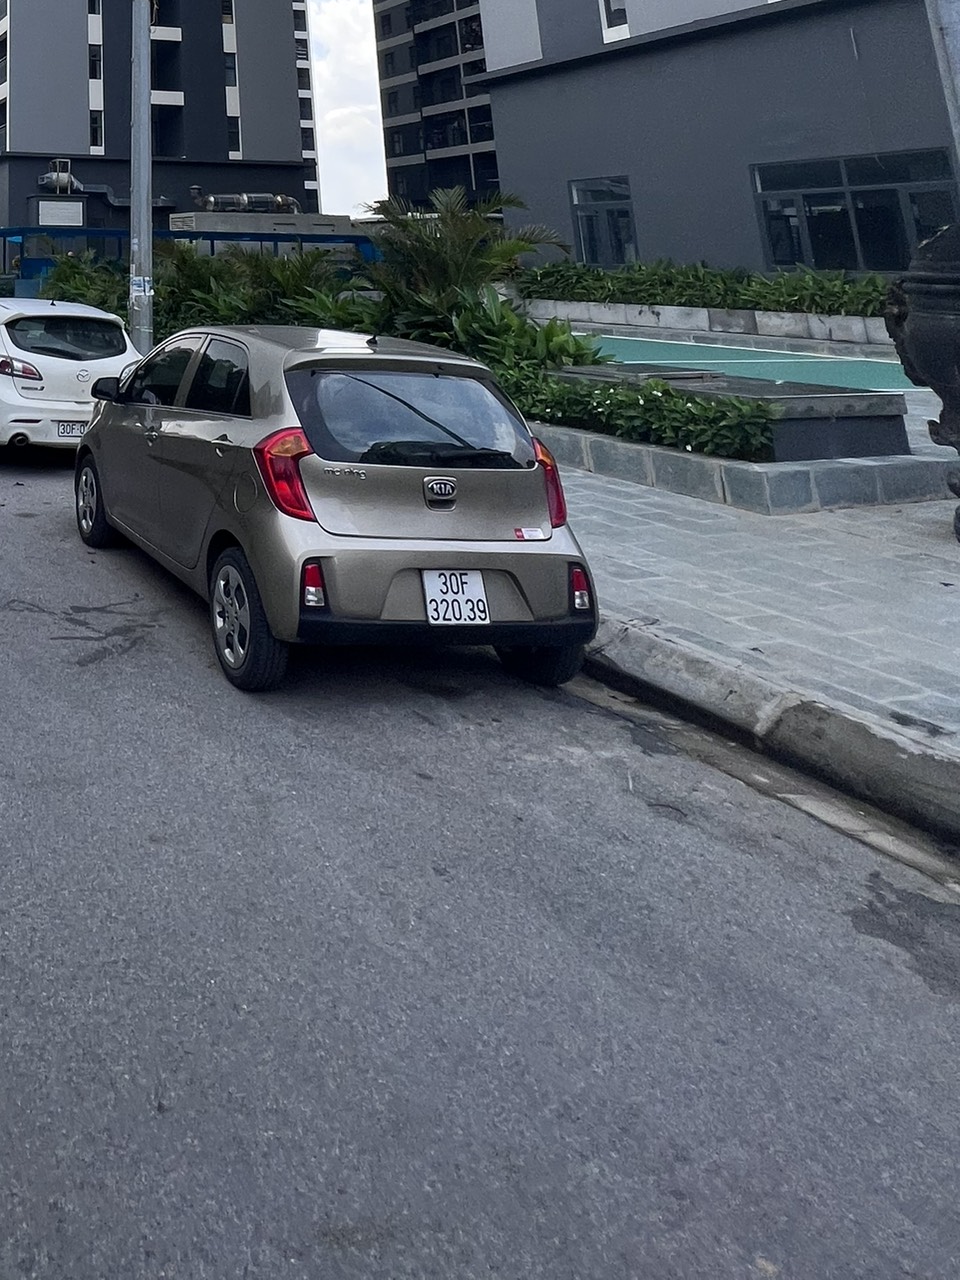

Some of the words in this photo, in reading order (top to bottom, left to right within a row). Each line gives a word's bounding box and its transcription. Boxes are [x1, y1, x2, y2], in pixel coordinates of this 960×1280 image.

[324, 467, 367, 480] moning
[432, 483, 453, 495] KIA
[438, 572, 469, 595] 30F
[429, 598, 488, 622] 320.39
